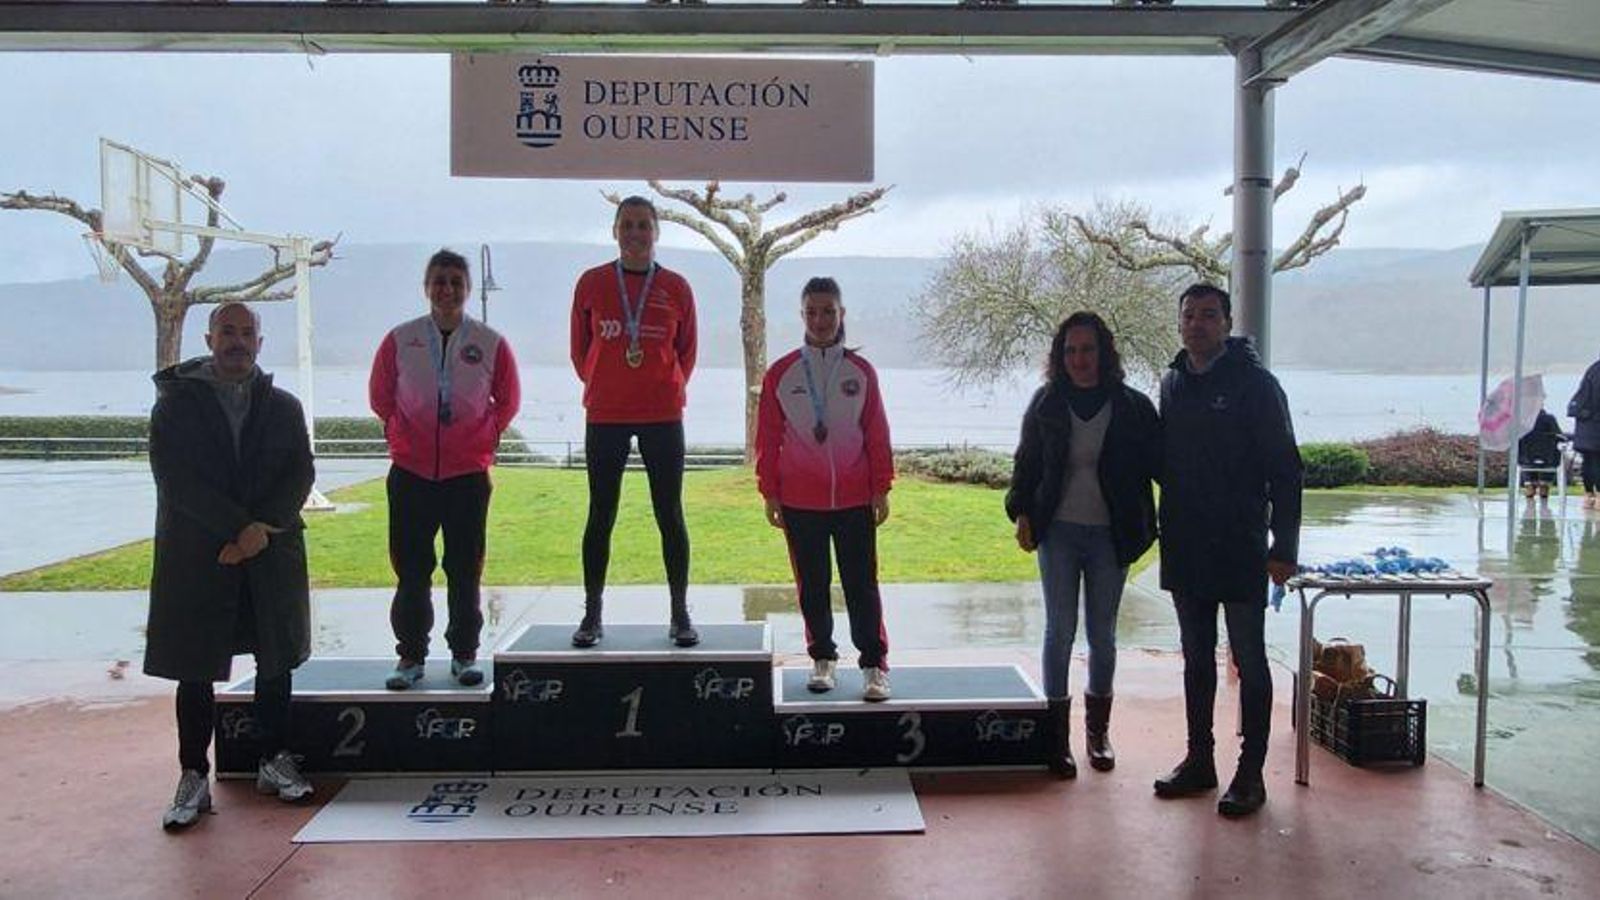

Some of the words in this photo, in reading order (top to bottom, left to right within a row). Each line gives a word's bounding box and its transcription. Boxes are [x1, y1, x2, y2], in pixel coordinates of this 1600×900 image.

[583, 76, 811, 107] DEPUTACIÓN
[583, 114, 749, 141] OURENSE
[615, 686, 645, 738] 1
[332, 706, 367, 757] 2
[896, 711, 927, 763] 3
[515, 781, 823, 800] DEPUTACIÓN
[504, 802, 739, 817] OURENSE
